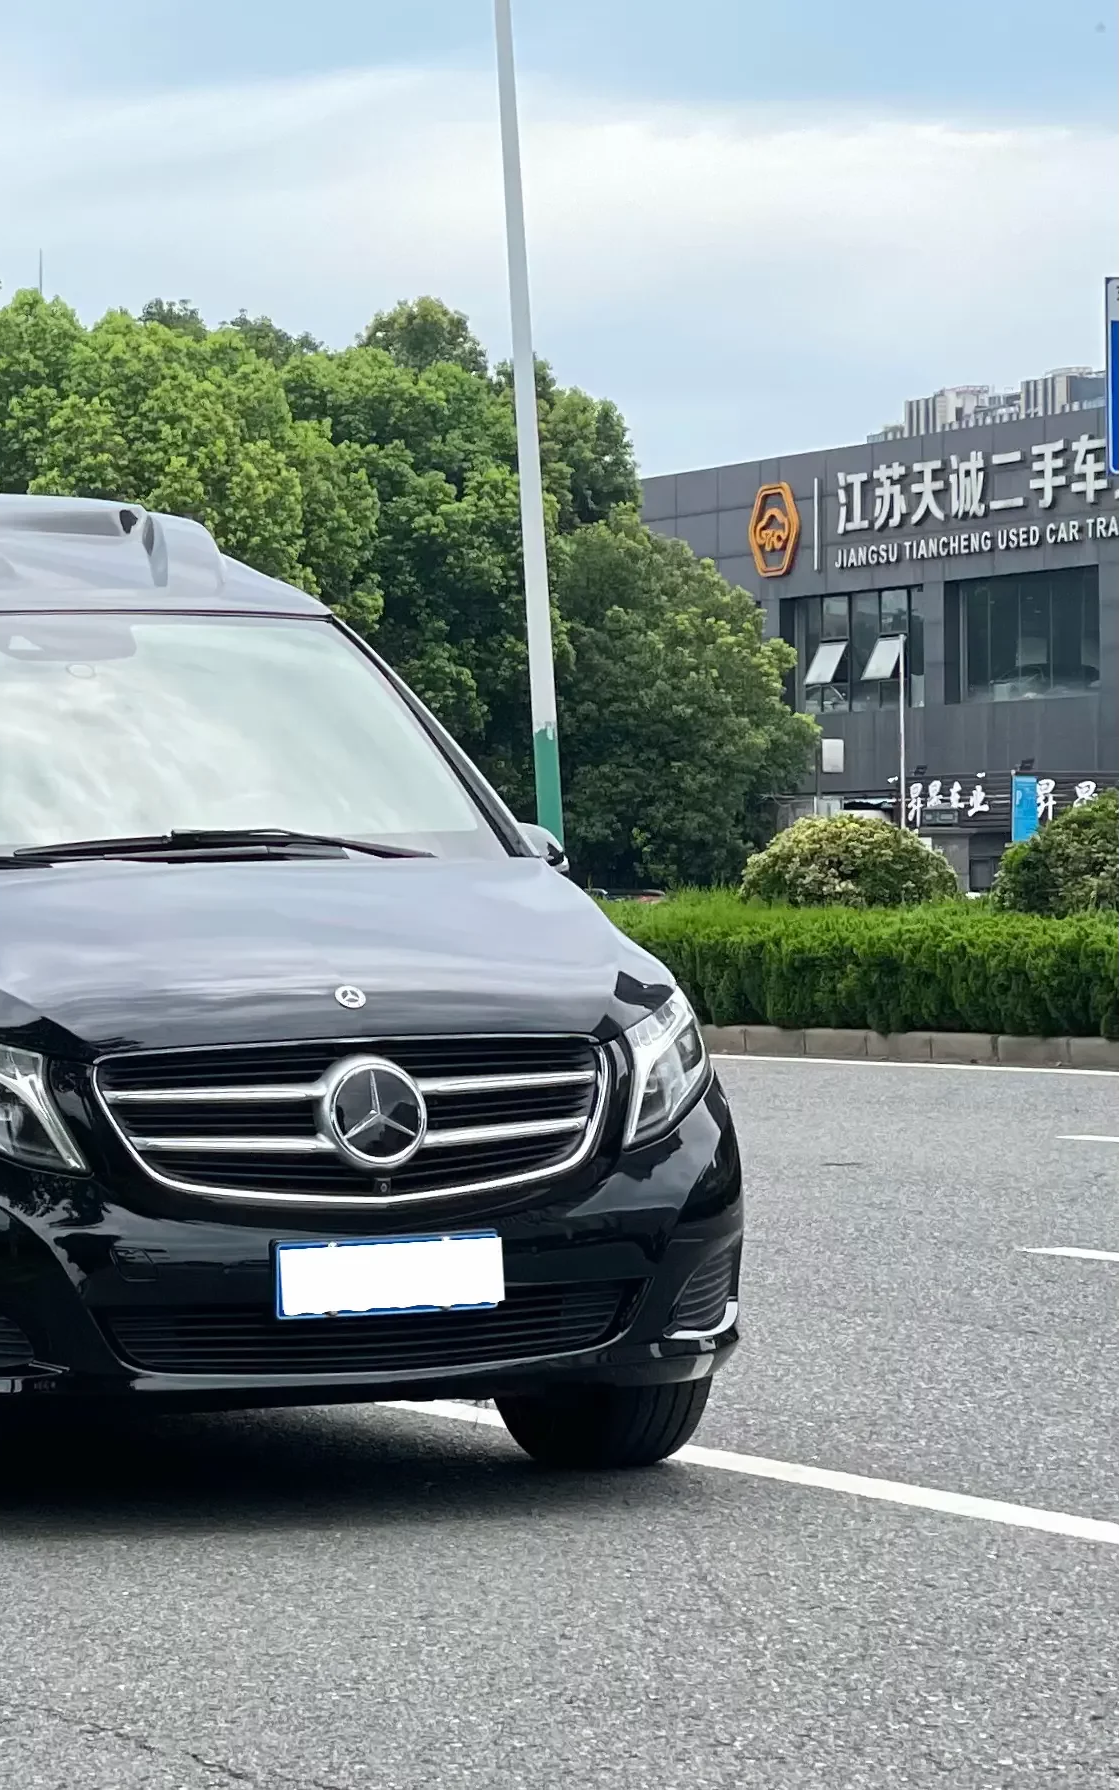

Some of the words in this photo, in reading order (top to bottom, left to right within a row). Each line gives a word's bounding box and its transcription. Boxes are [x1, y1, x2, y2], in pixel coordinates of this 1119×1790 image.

[837, 433, 1119, 534] 江苏天诚二手车
[834, 543, 898, 569] JIANGSU
[903, 530, 992, 560] TIANCHENG
[997, 525, 1040, 550] USED
[1046, 520, 1080, 544] CAR
[1085, 515, 1119, 539] TRA
